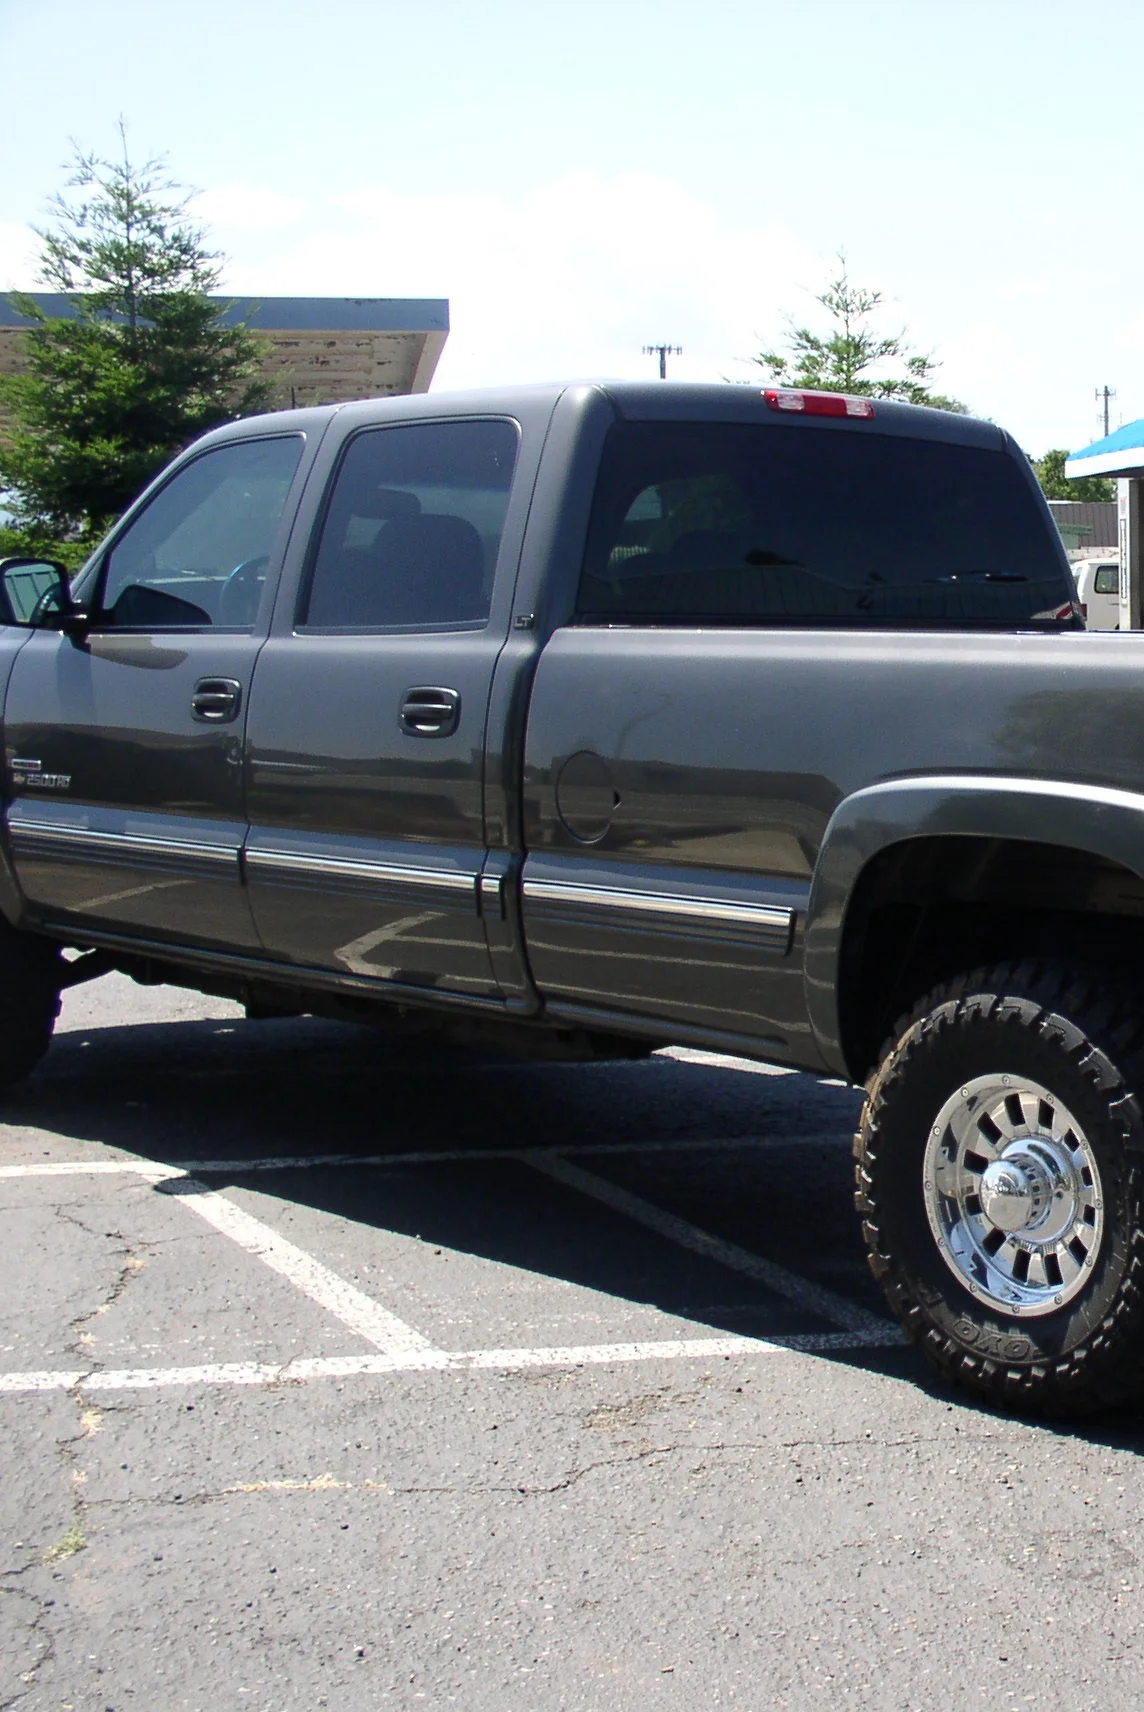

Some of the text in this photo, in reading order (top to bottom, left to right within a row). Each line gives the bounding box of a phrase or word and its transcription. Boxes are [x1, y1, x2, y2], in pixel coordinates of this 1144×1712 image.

[514, 616, 531, 628] LT
[28, 774, 56, 788] 2500
[953, 1318, 1042, 1360] OYO
